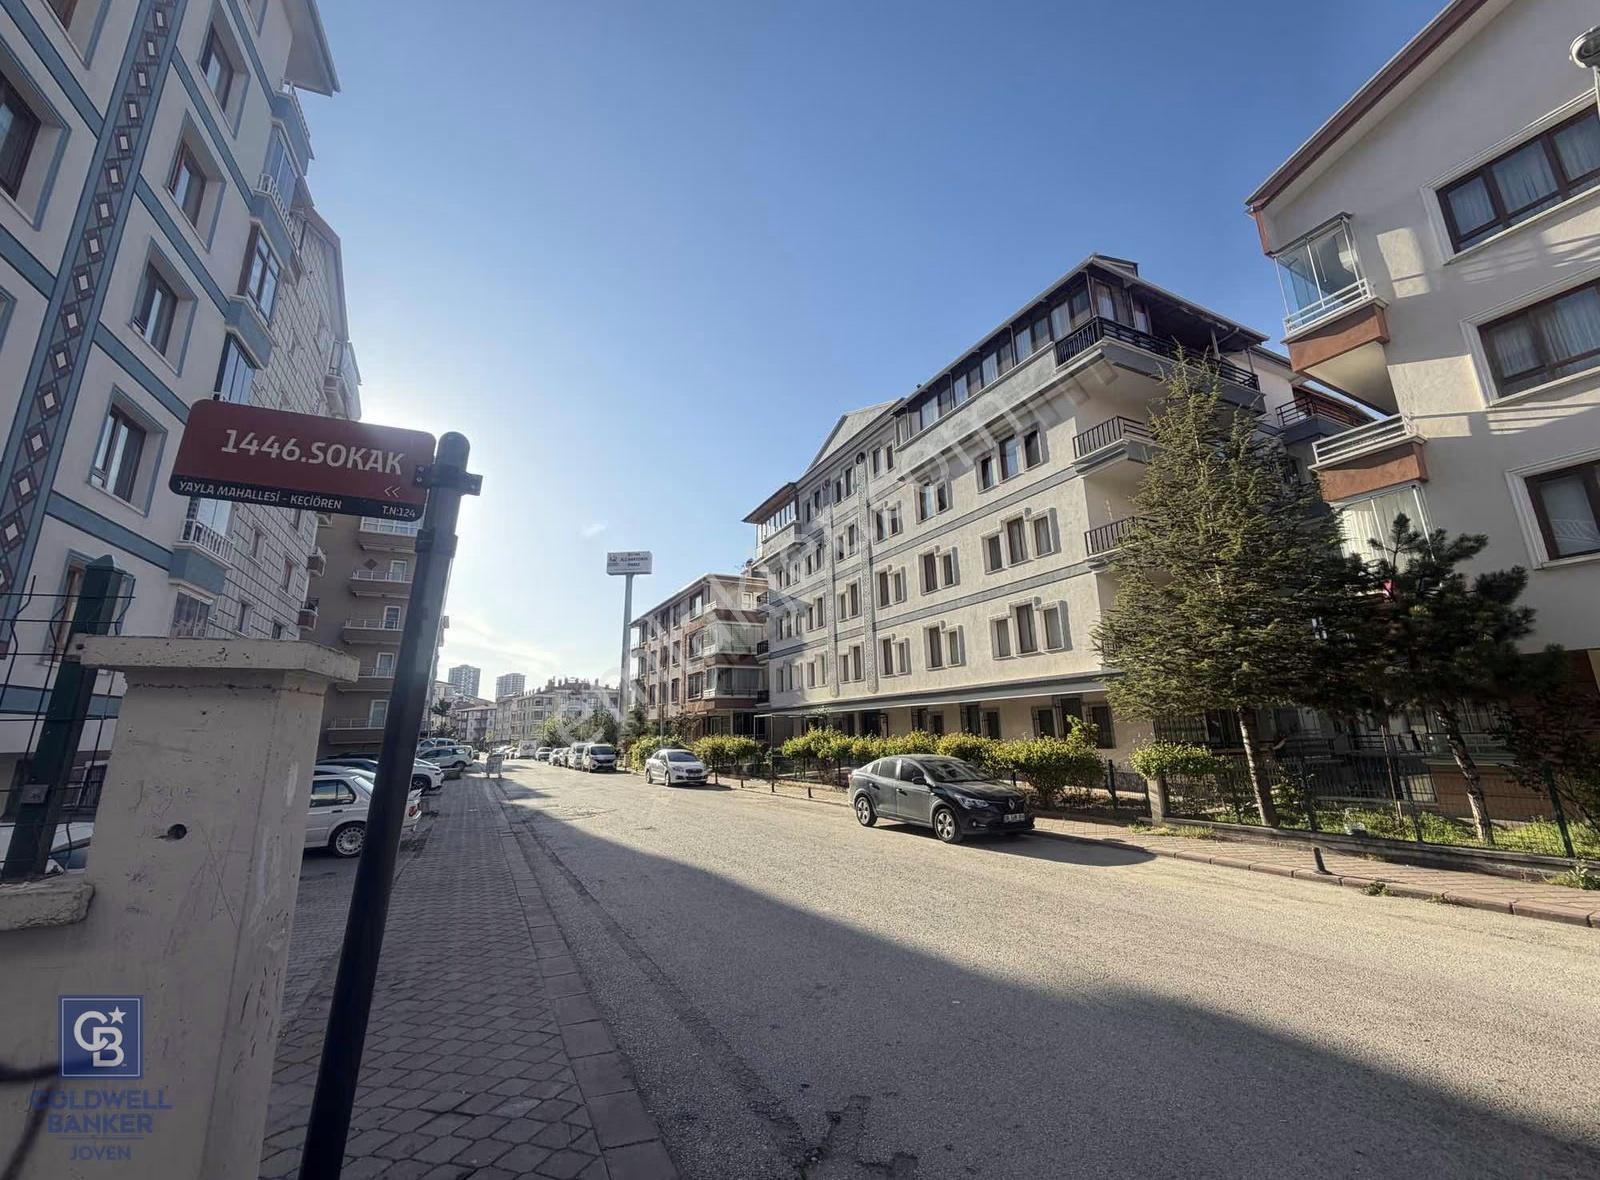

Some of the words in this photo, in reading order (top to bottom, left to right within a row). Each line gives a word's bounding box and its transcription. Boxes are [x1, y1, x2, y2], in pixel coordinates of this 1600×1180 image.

[220, 429, 405, 476] 1446.SOKAK
[179, 481, 214, 495] YAYLA
[216, 485, 281, 502] MAHALLESİ
[290, 494, 342, 510] KEÇİÖREN
